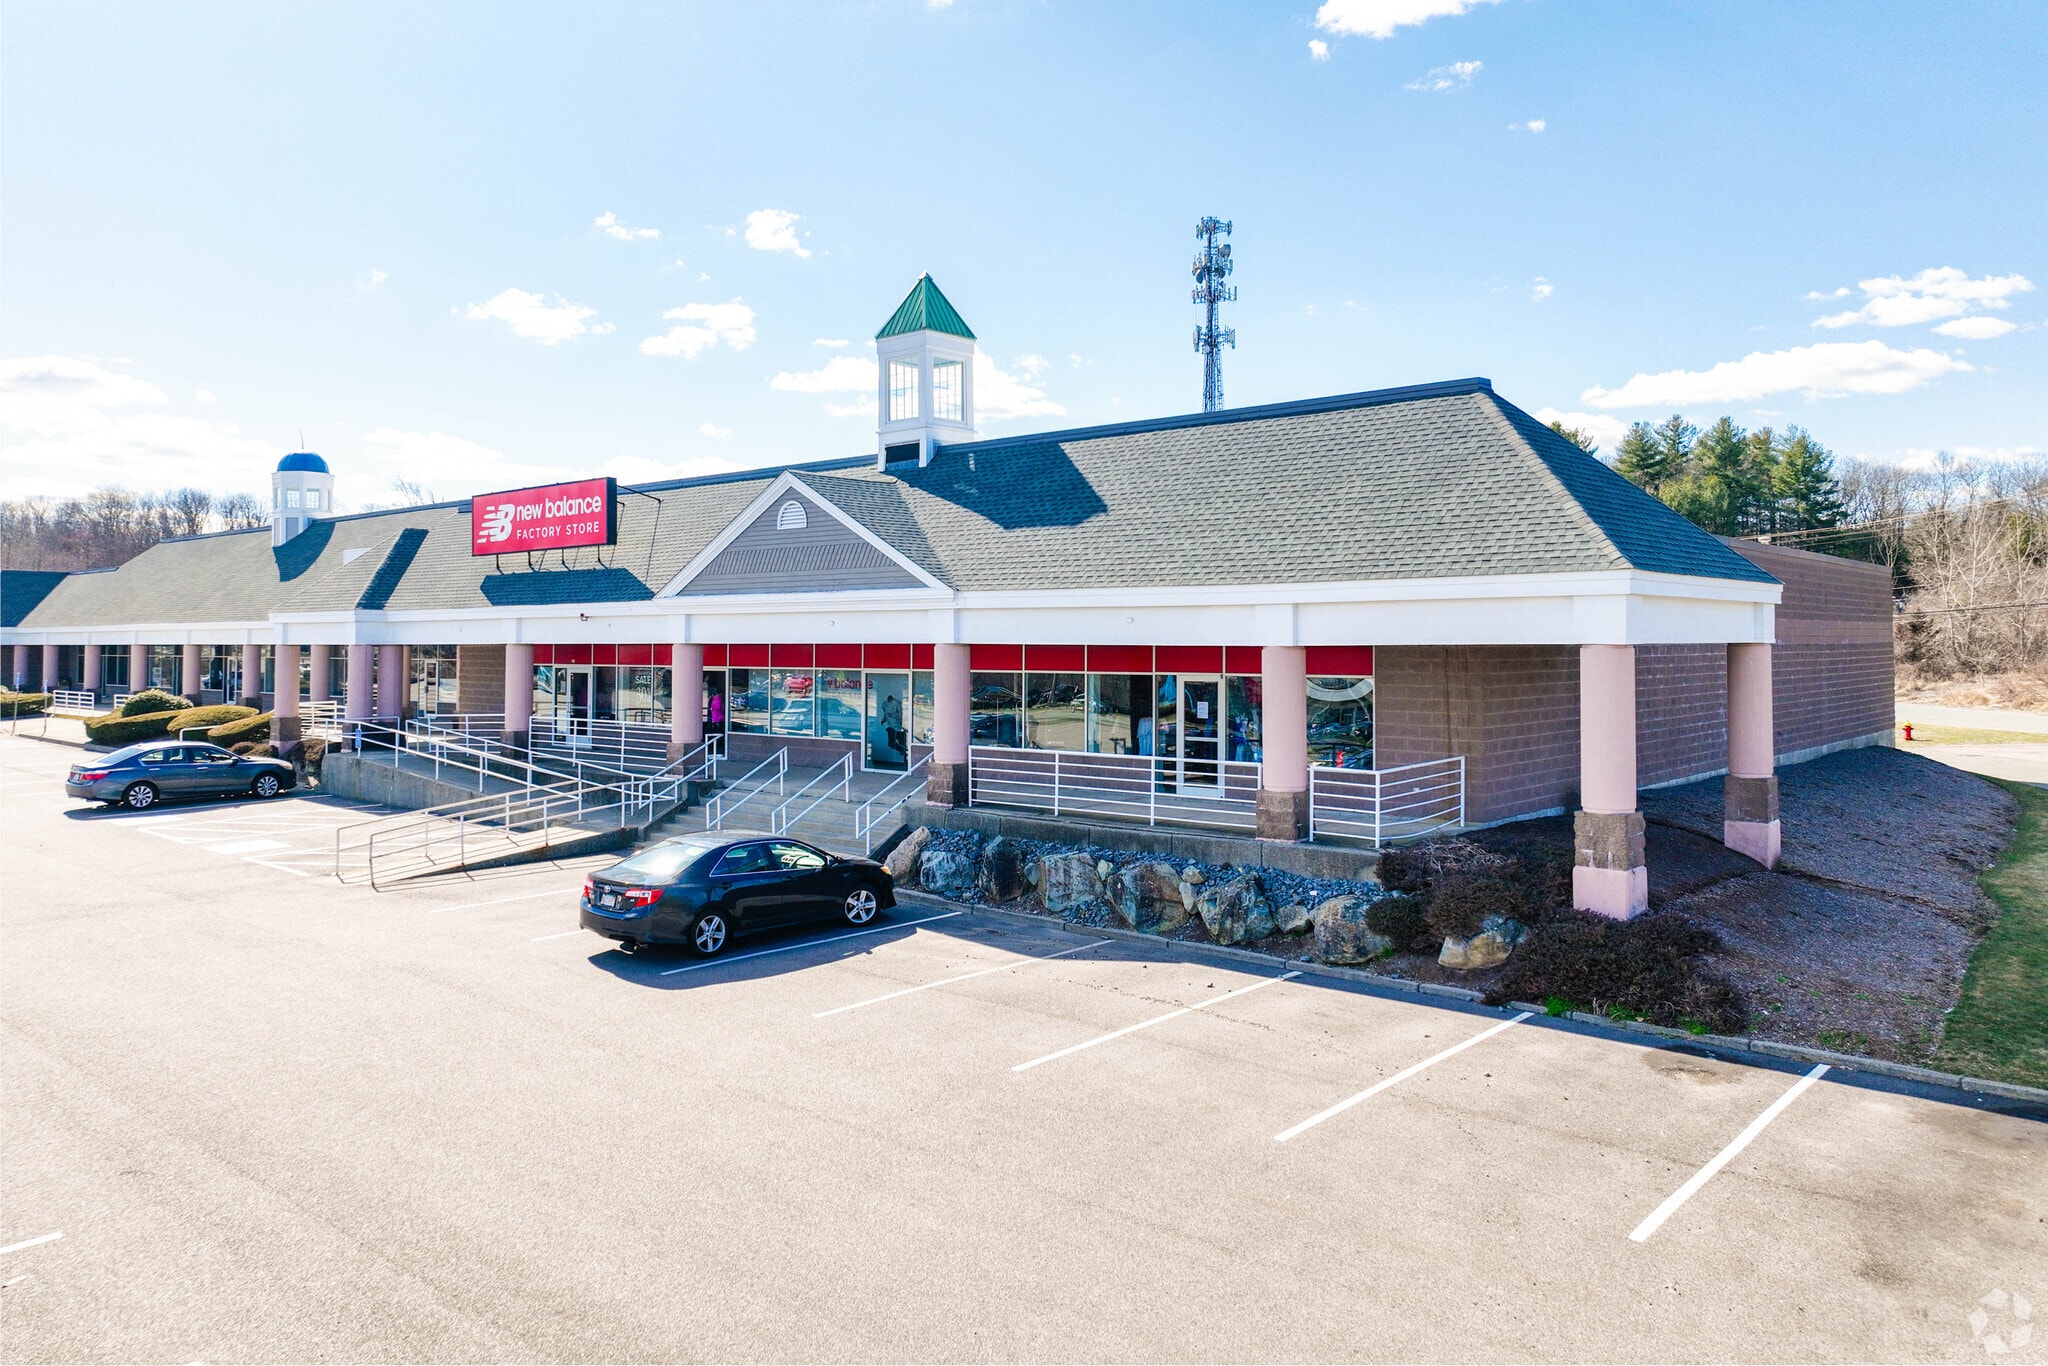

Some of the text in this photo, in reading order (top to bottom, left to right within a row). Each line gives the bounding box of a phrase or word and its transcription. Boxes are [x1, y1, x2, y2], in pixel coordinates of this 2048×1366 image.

[517, 496, 601, 521] new balance
[517, 522, 599, 540] FACTORY STORE
[635, 675, 652, 684] SALE
[834, 677, 873, 689] balane
